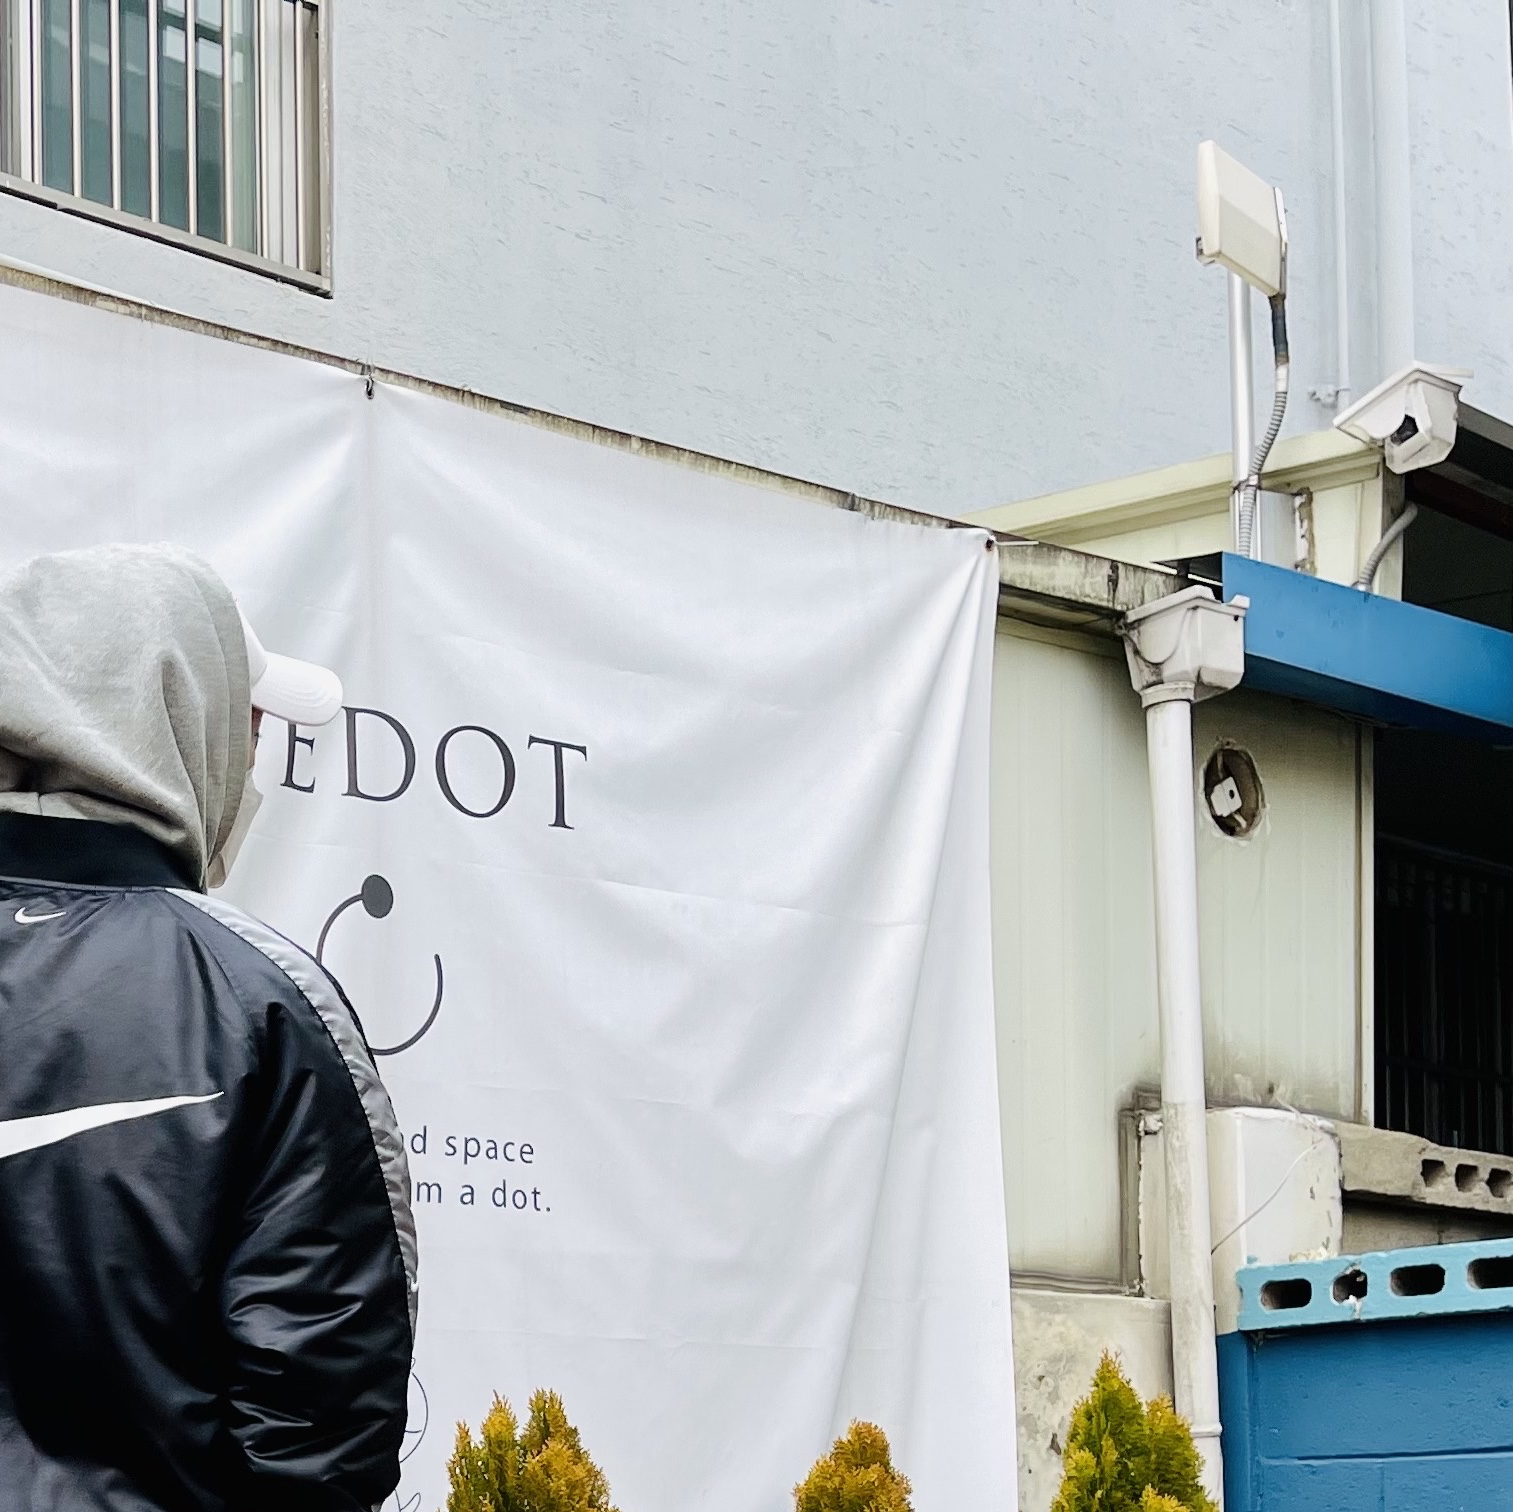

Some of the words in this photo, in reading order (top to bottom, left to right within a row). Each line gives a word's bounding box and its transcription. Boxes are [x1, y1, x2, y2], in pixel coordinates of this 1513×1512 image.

[444, 1135, 534, 1165] space
[459, 1184, 475, 1206] a
[491, 1179, 551, 1212] dot.
